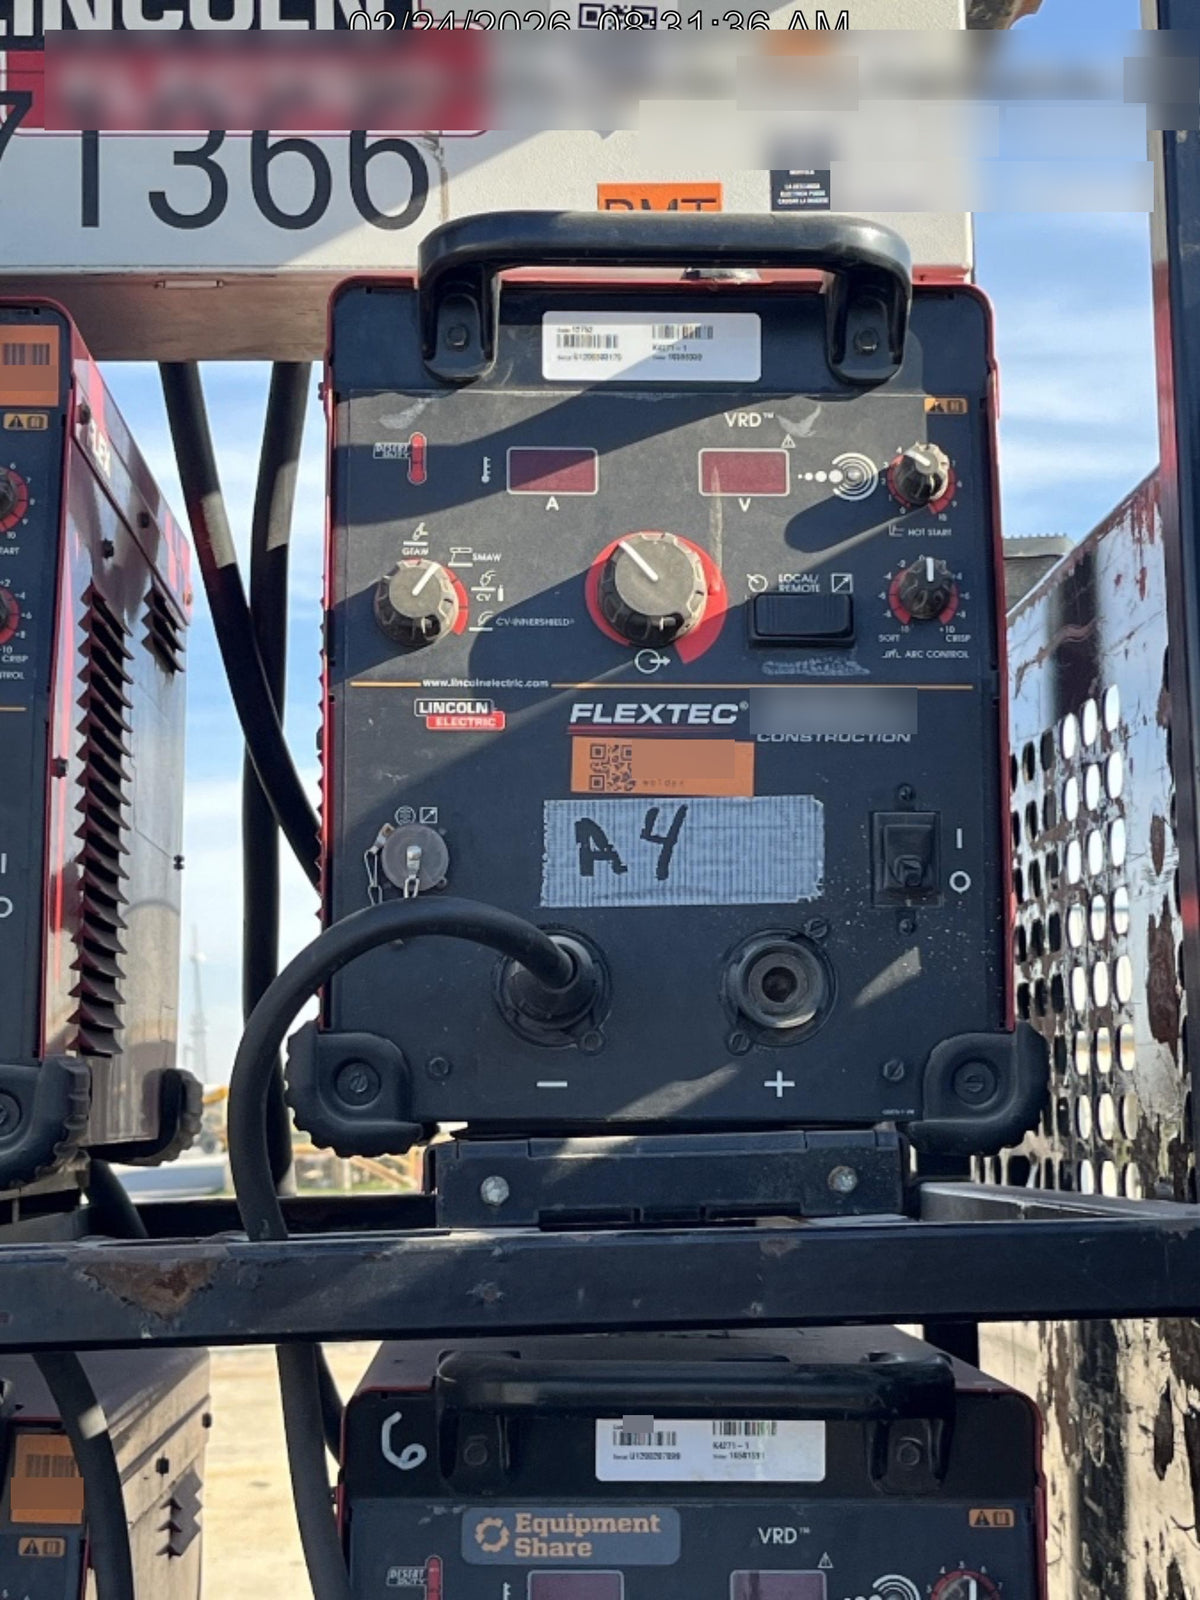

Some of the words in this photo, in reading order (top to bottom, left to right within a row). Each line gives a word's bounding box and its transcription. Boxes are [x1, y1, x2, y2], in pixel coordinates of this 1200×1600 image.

[0, 0, 385, 36] INCOLN
[546, 496, 560, 511] A
[738, 498, 752, 512] V
[908, 527, 926, 536] HOT
[927, 528, 952, 536] START
[472, 554, 502, 562] SMAW
[778, 573, 820, 583] LOCAL/
[778, 584, 820, 592] REMOTE
[475, 593, 492, 602] CV
[925, 650, 969, 658] CONTROL
[422, 678, 549, 687] www.lincolnelectric.com
[418, 701, 489, 714] LINCOLN
[435, 716, 497, 727] ELECTRIC
[381, 1411, 427, 1471] 6
[515, 1512, 662, 1537] Equipment
[514, 1537, 593, 1558] Share
